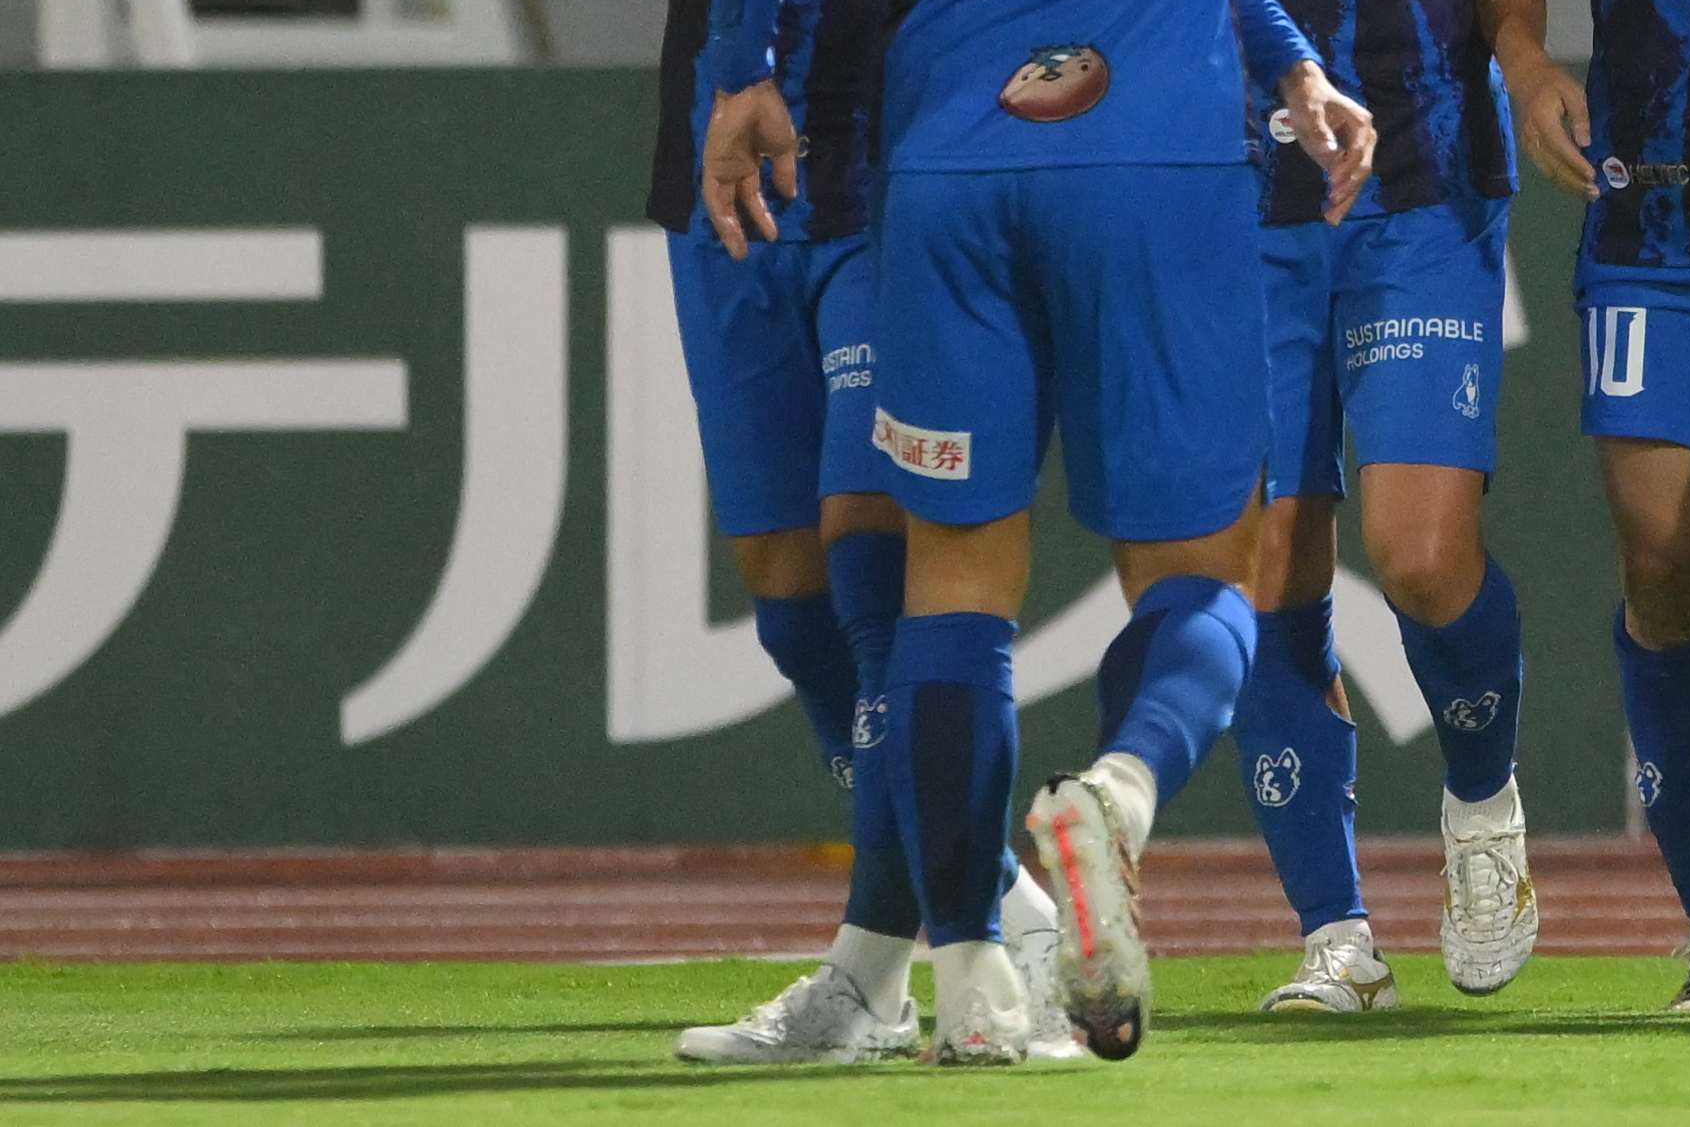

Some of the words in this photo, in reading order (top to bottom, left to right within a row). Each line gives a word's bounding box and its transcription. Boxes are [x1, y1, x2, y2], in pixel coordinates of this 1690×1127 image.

[1346, 318, 1484, 349] SUSTAINABLE
[1347, 343, 1423, 371] HOLDINGS
[1588, 306, 1647, 397] 10
